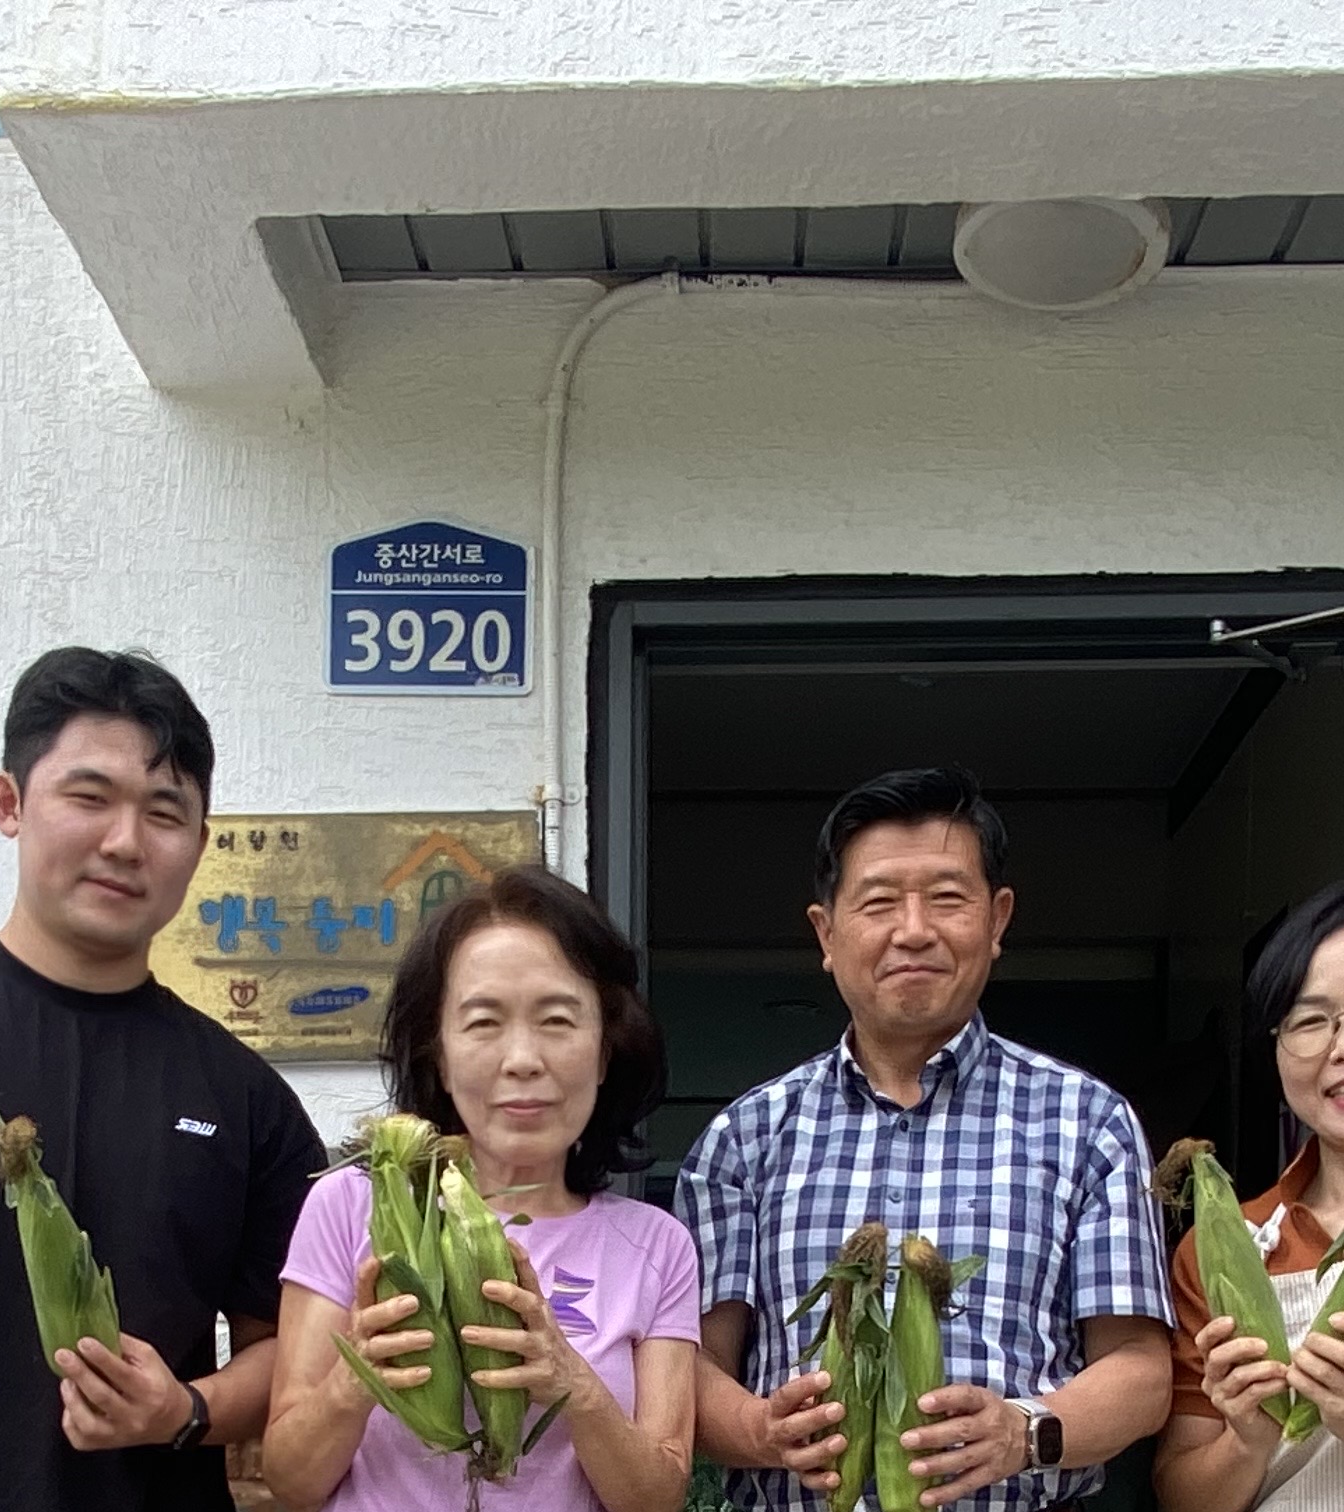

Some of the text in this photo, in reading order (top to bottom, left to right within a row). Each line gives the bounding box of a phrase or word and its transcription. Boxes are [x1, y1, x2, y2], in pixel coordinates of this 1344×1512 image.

[374, 543, 486, 568] 중산간서로
[354, 570, 504, 586] Jungsanganseo-ro
[344, 609, 512, 673] 3920
